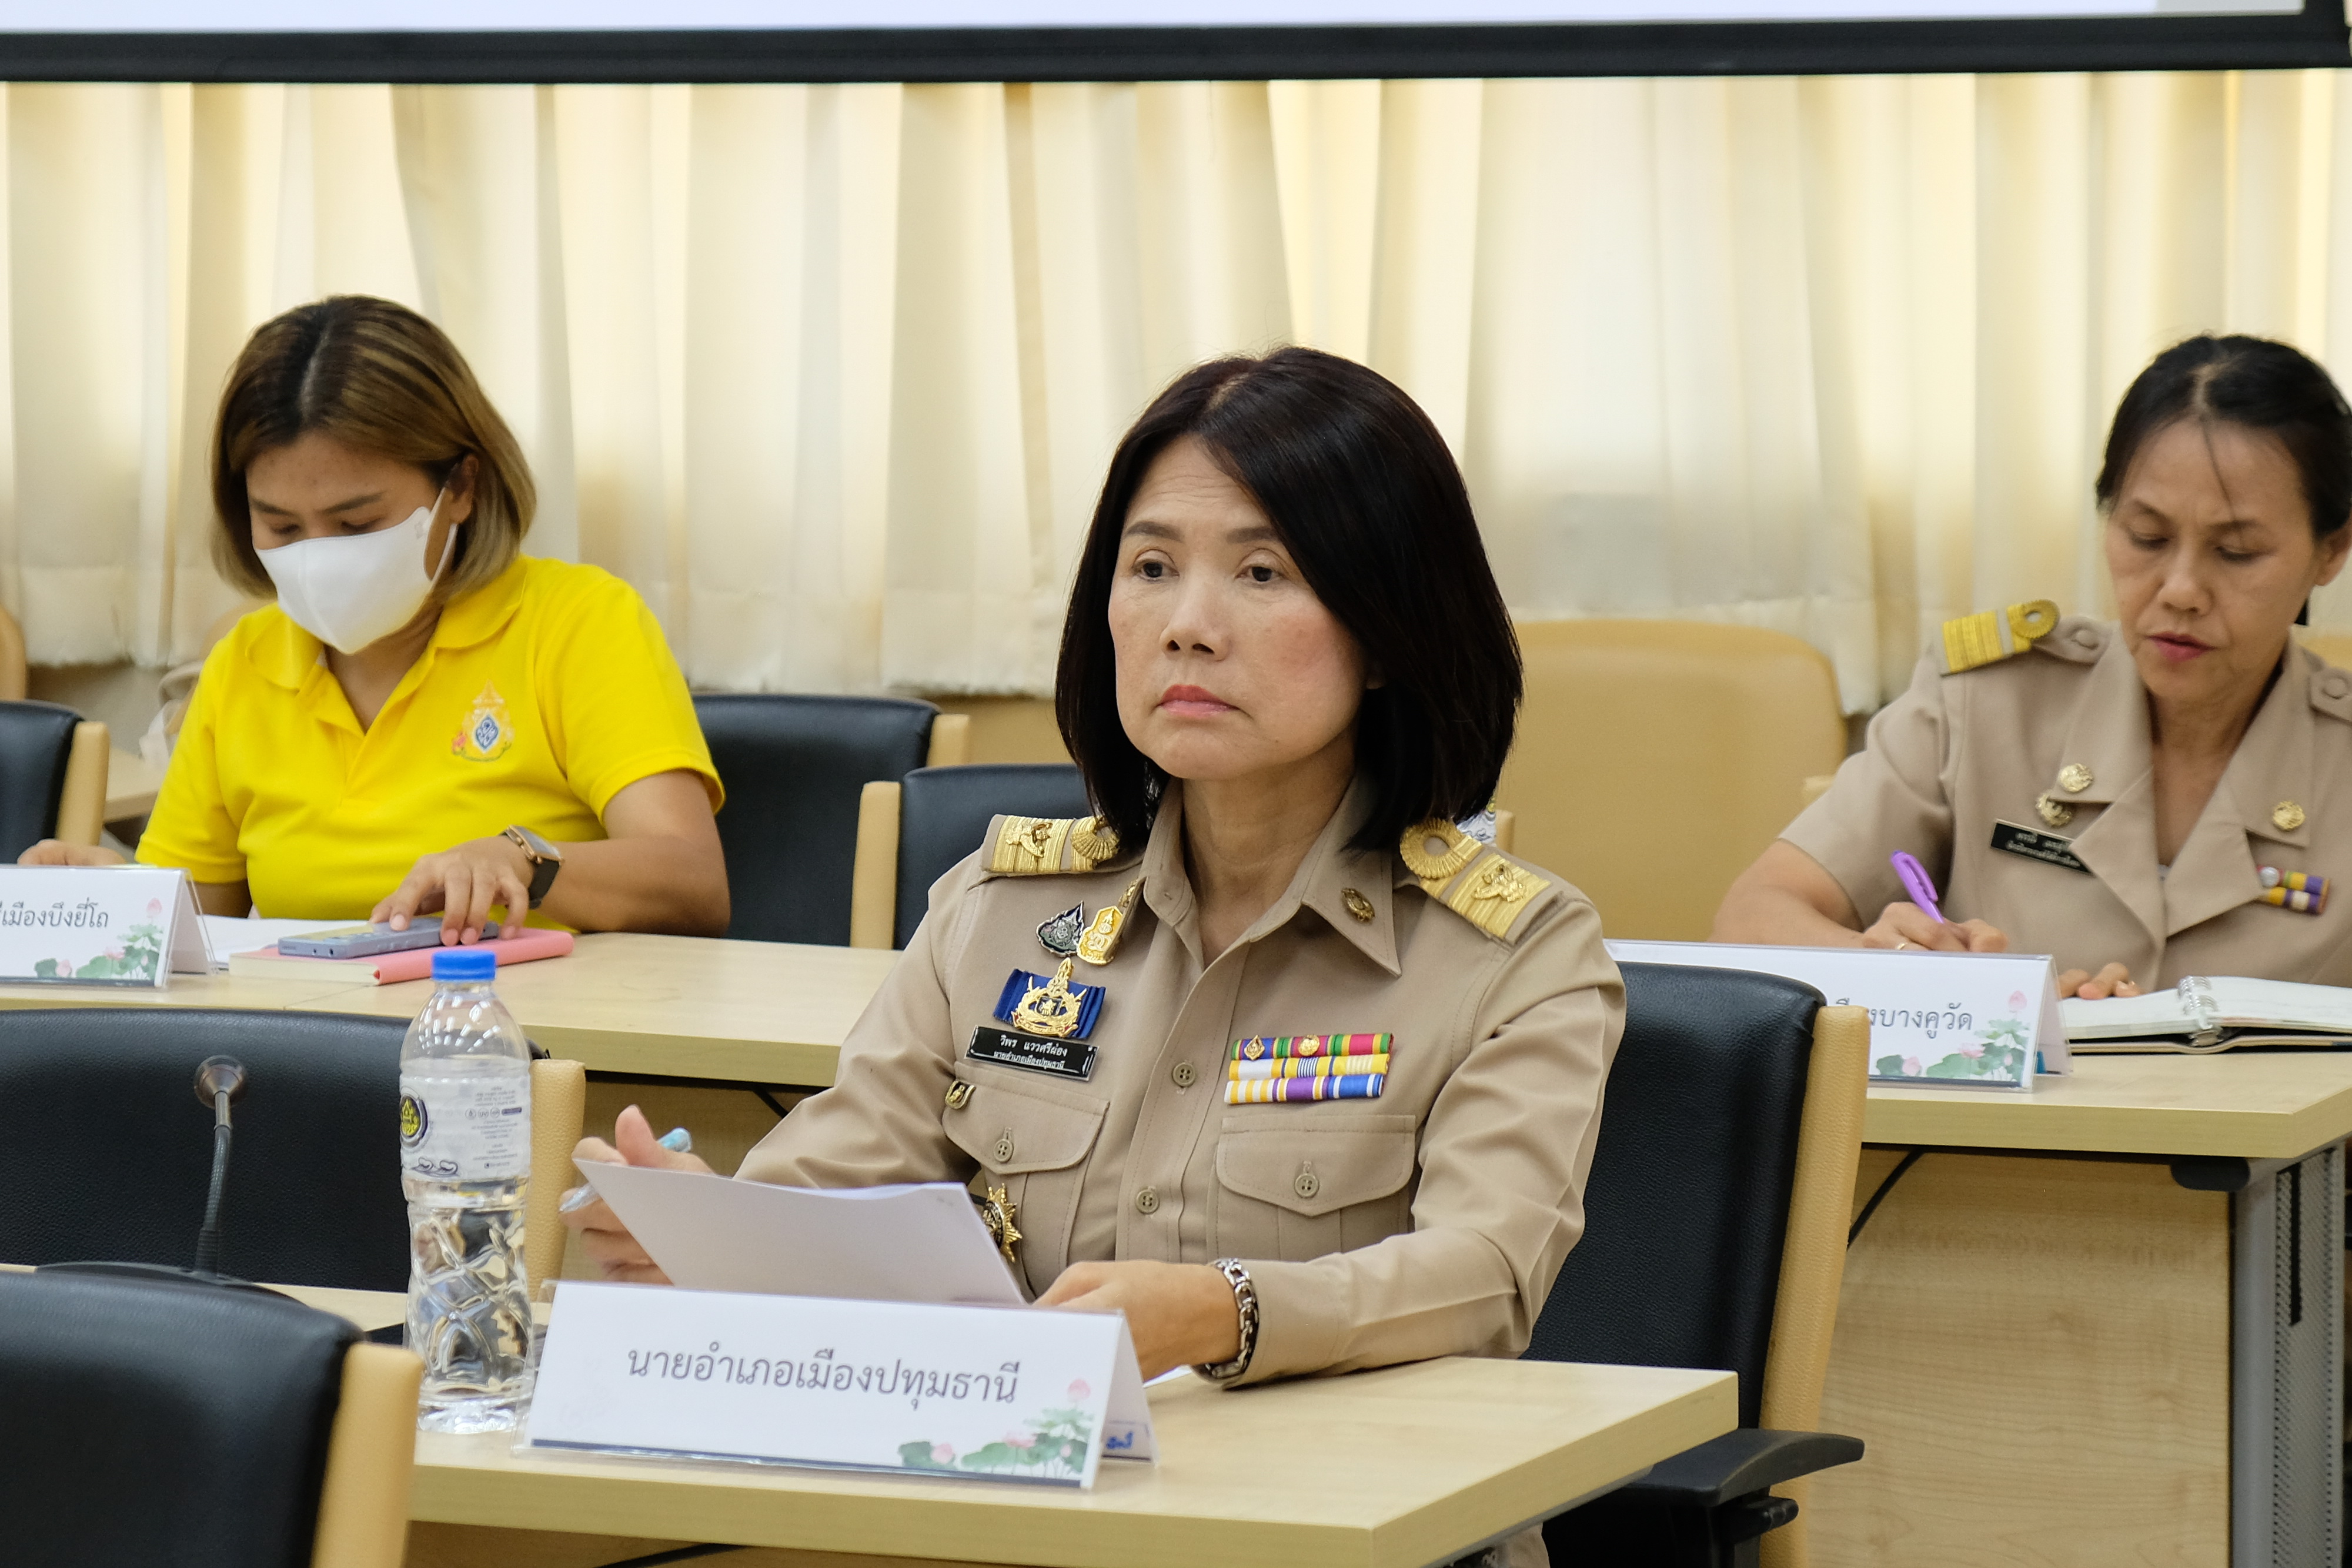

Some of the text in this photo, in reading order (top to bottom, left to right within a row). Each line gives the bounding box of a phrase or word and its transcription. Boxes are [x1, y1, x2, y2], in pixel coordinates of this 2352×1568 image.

[0, 897, 108, 928] เมืองบึงยี่โถ
[1000, 1034, 1067, 1057] วิพร แววศรีผ่อง
[627, 1342, 1019, 1410] นายอำเภอเมืองปทุมธานี
